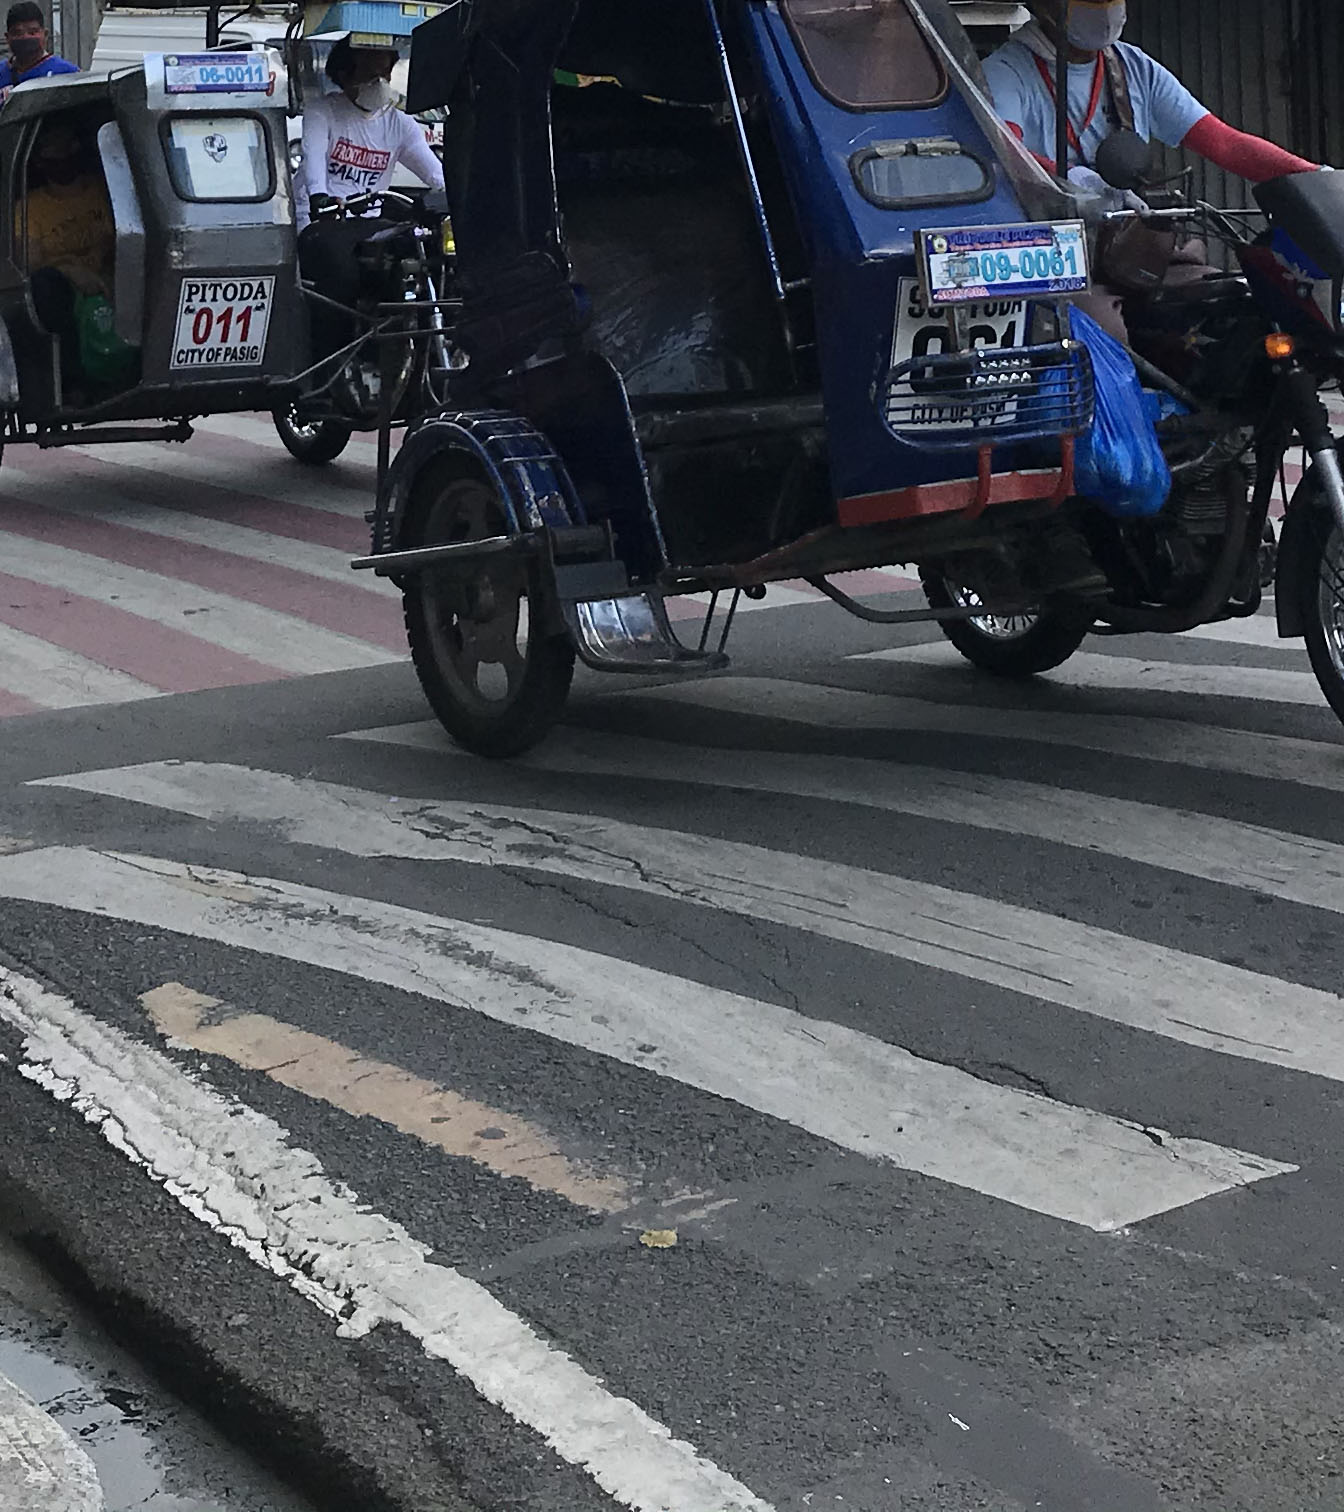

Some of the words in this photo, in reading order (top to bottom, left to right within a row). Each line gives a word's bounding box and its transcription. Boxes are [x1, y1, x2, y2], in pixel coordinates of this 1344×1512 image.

[980, 245, 1078, 283] 09-0061
[185, 280, 268, 303] PITODA
[192, 304, 253, 345] 011
[176, 348, 206, 364] CITY
[206, 347, 223, 363] OF
[223, 345, 259, 362] PASIG
